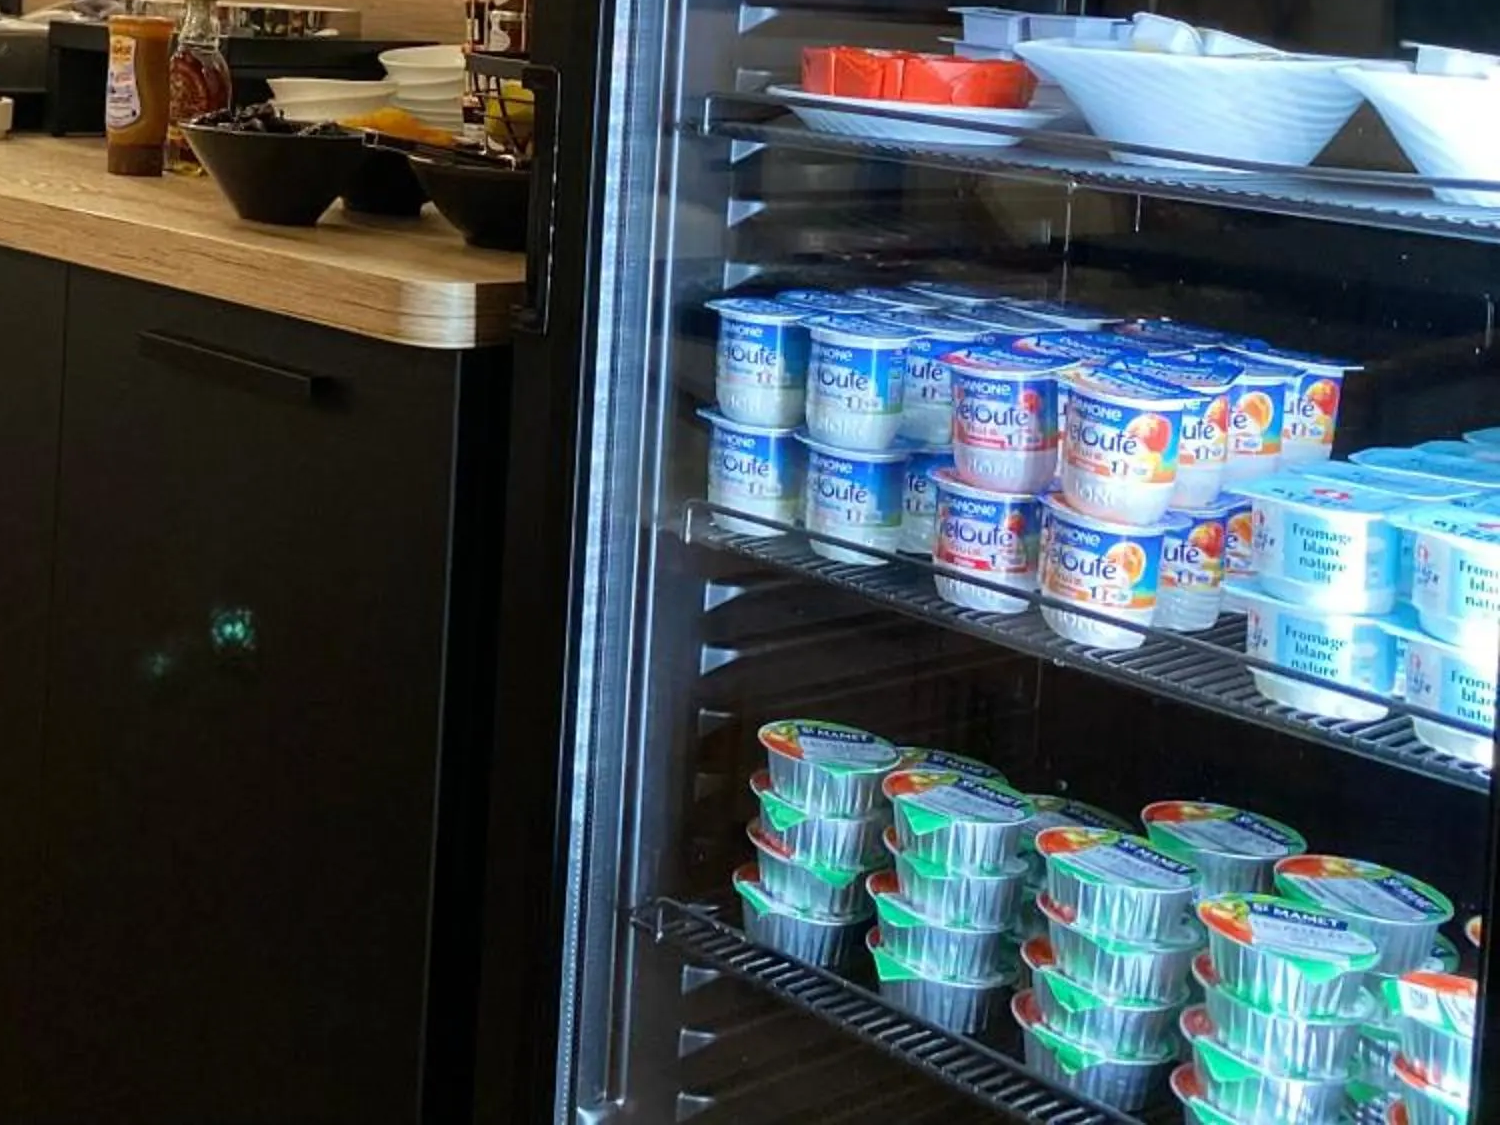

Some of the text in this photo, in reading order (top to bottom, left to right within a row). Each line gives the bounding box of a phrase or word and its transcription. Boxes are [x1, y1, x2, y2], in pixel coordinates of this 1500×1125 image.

[1284, 624, 1347, 651] Fromage
[1295, 641, 1334, 662] blanc
[1291, 658, 1339, 678] nature
[817, 727, 869, 742] MAMET
[1271, 908, 1340, 928] MAMET
